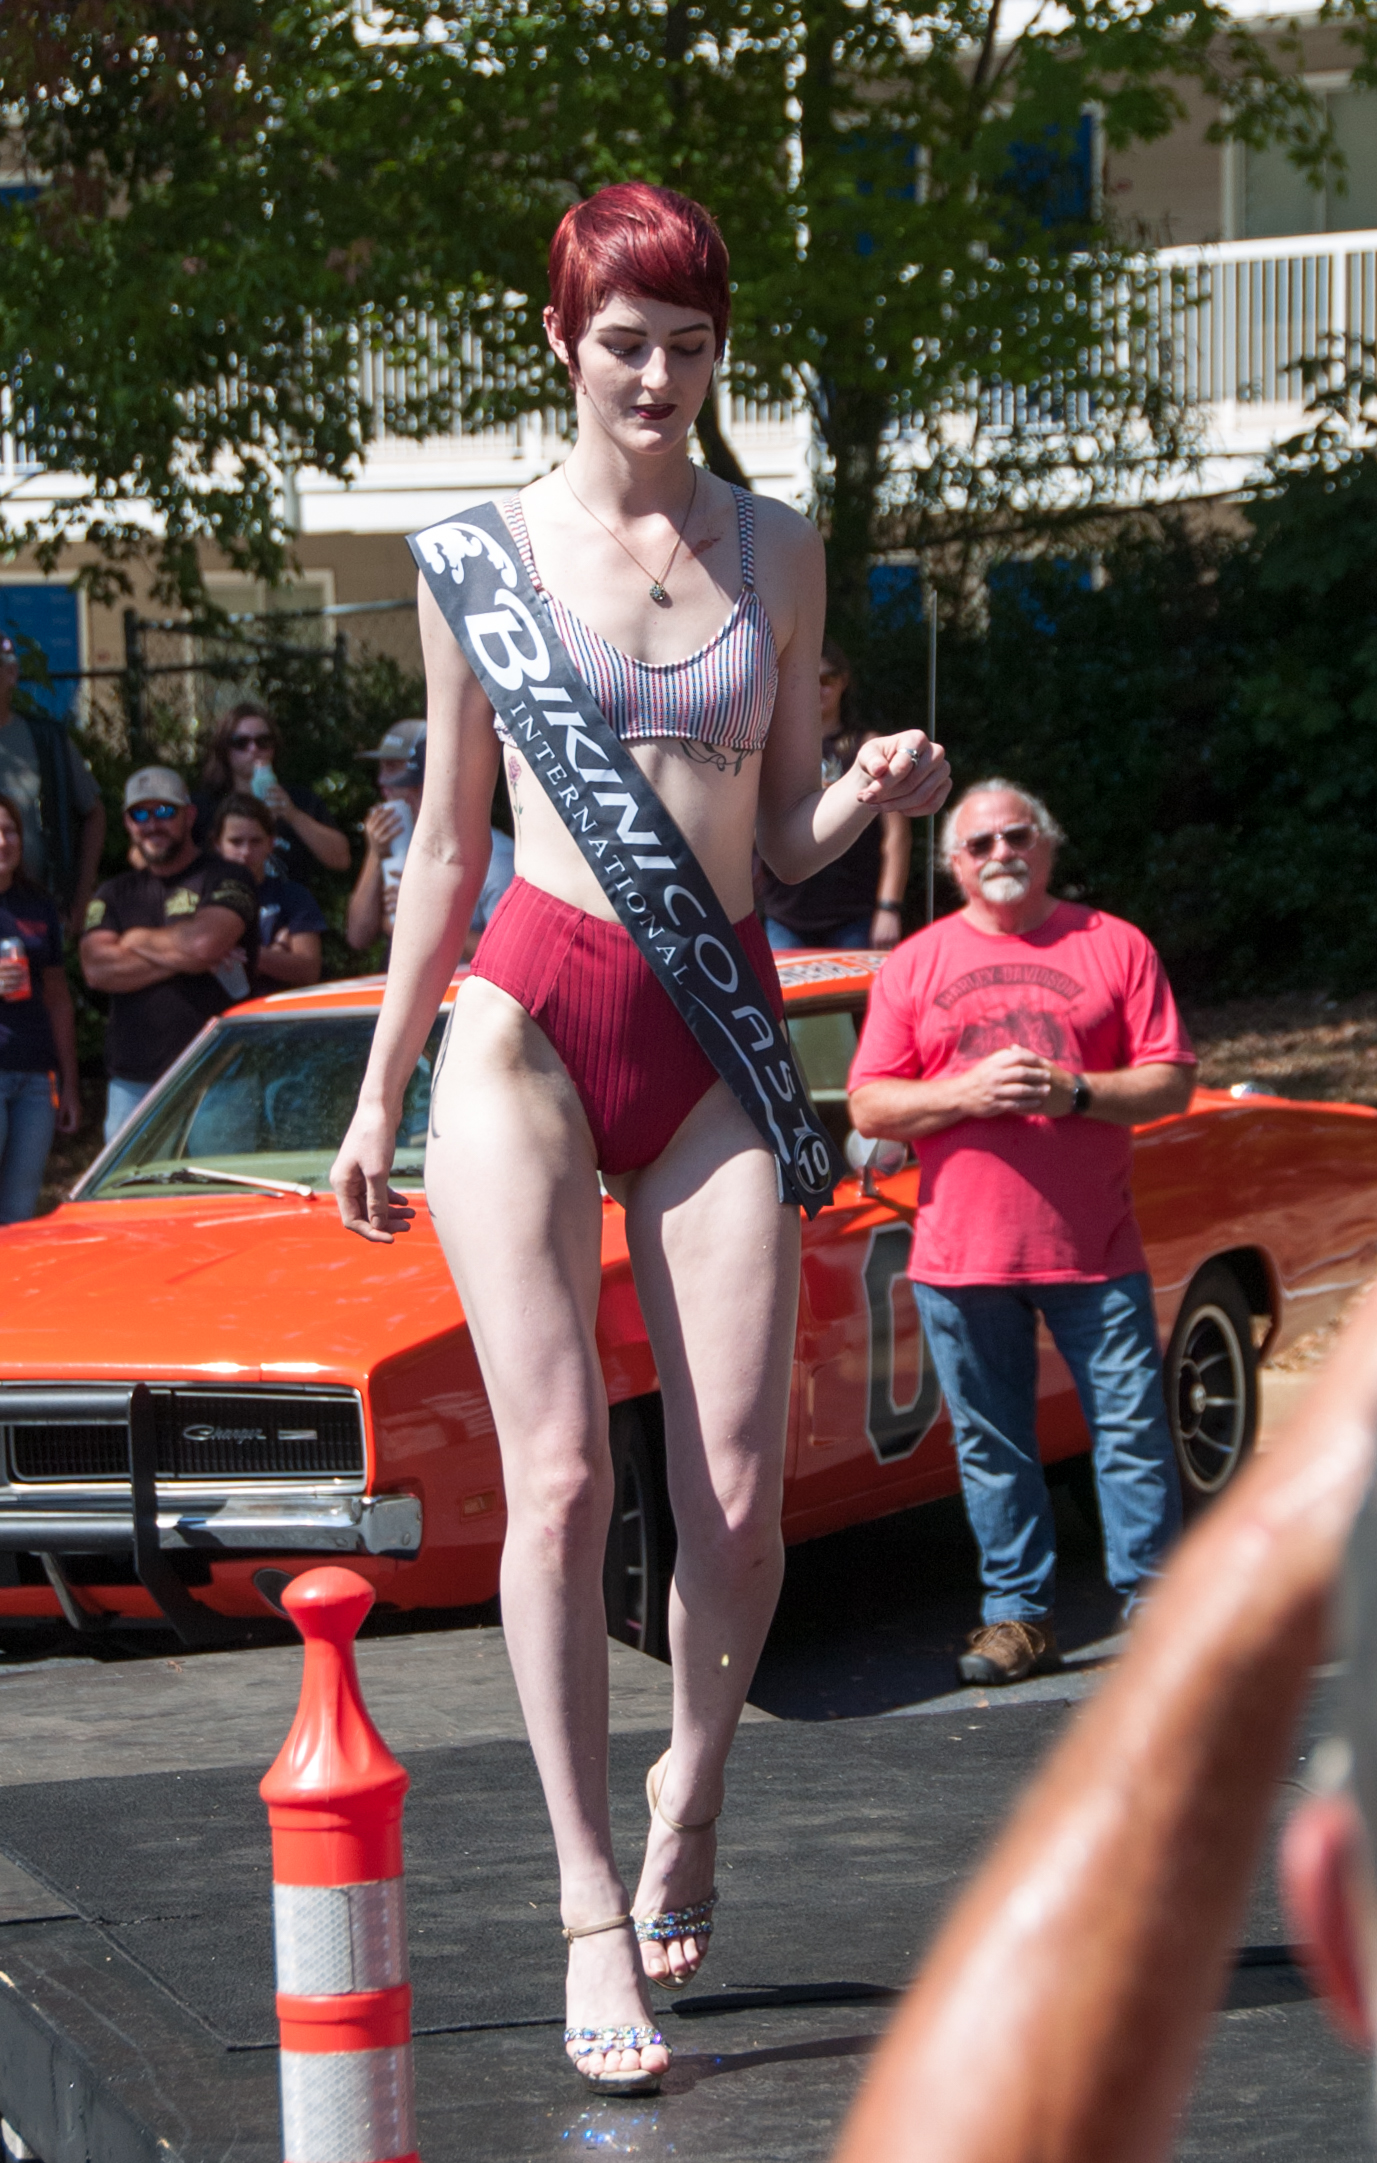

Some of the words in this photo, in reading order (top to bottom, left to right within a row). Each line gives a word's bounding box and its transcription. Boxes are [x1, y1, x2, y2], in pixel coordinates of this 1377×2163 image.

[464, 588, 677, 870] BIKINI
[510, 701, 691, 985] INTERNATIONAL
[799, 1140, 830, 1185] 10
